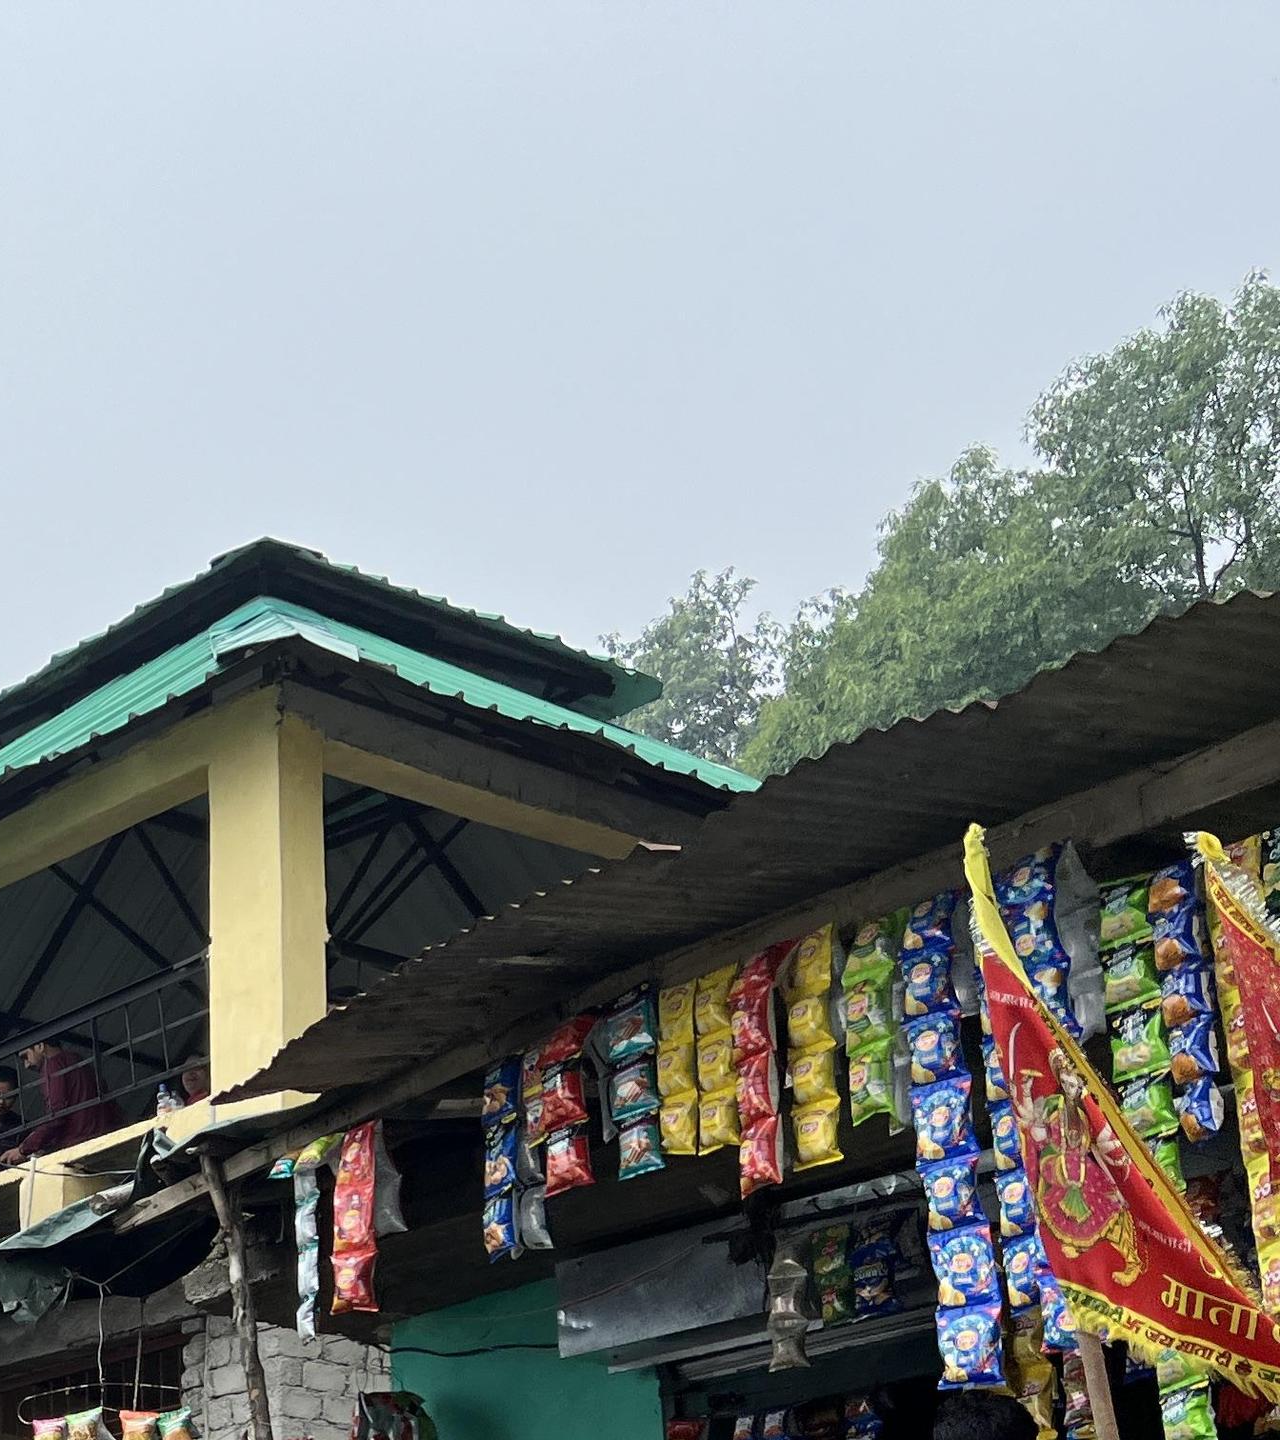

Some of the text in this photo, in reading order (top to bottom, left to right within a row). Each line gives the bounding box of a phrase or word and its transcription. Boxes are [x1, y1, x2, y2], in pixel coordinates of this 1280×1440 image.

[1161, 1274, 1262, 1340] माता
[1145, 1326, 1173, 1349] जय
[1175, 1340, 1213, 1360] माता
